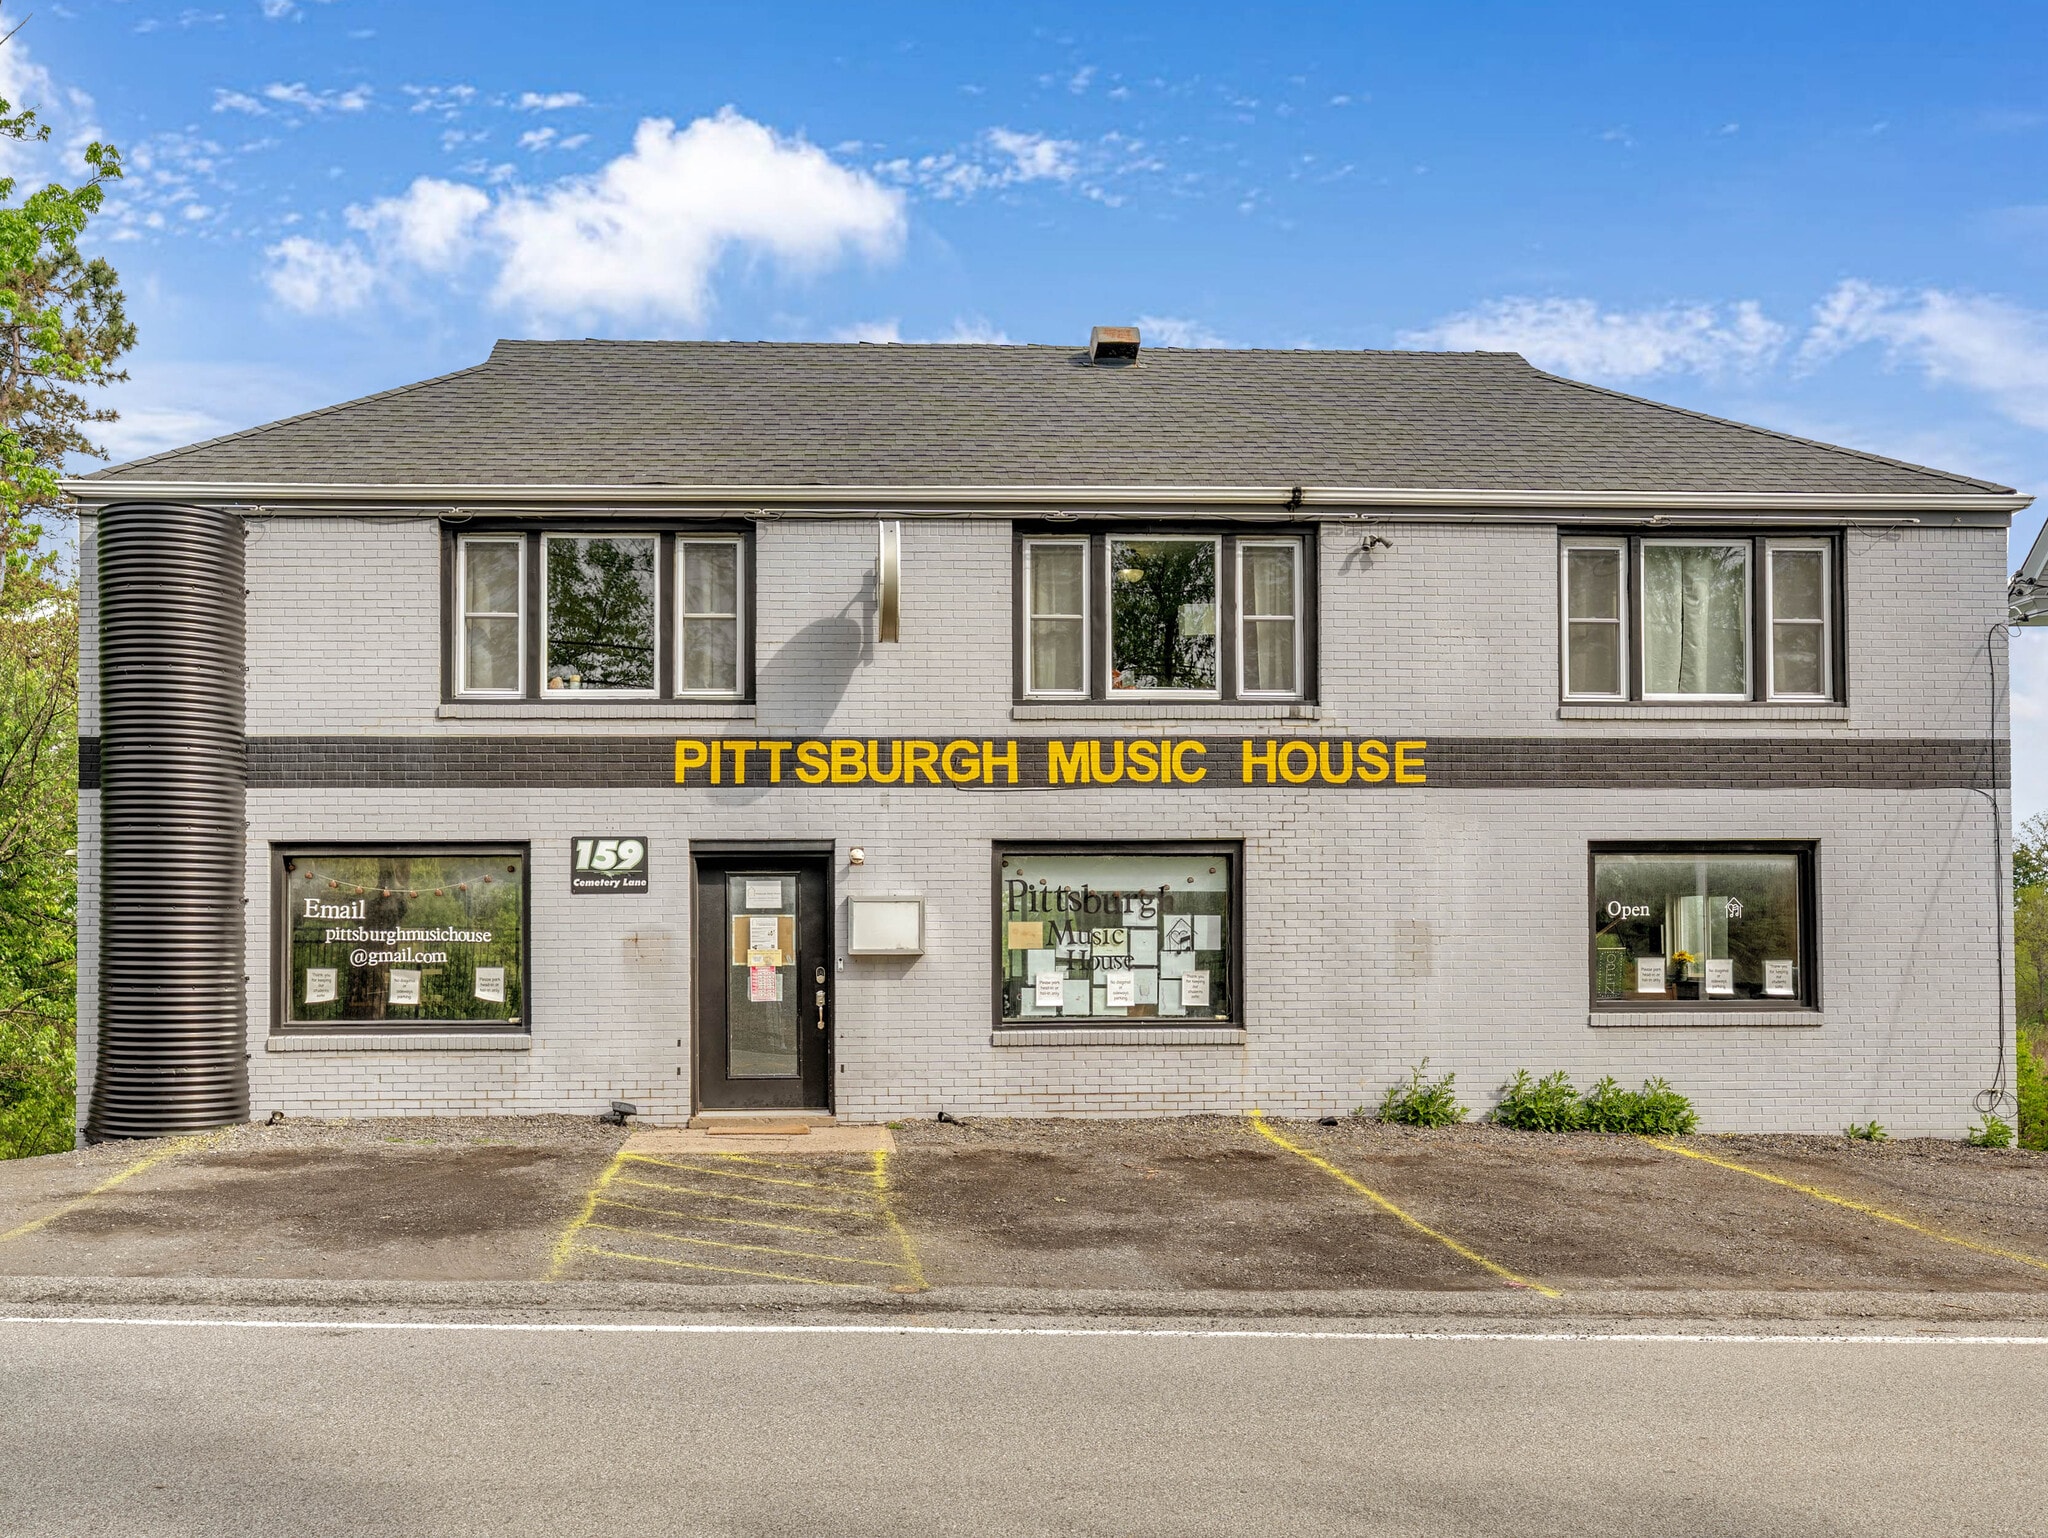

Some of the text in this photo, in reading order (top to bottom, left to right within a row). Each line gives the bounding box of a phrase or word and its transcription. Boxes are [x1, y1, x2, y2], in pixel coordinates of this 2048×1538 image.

[674, 740, 1427, 784] PITTSBURGH MUSIC HOUSE
[575, 839, 644, 870] 159
[573, 878, 647, 889] Cemetery Lane
[303, 898, 366, 920] Email
[1004, 879, 1175, 919] Pittsburgh
[1607, 900, 1650, 920] Open
[325, 926, 492, 946] pittsburghmusichouse
[1046, 919, 1124, 946] Music
[350, 948, 448, 967] @gmail.com
[1066, 949, 1135, 972] House
